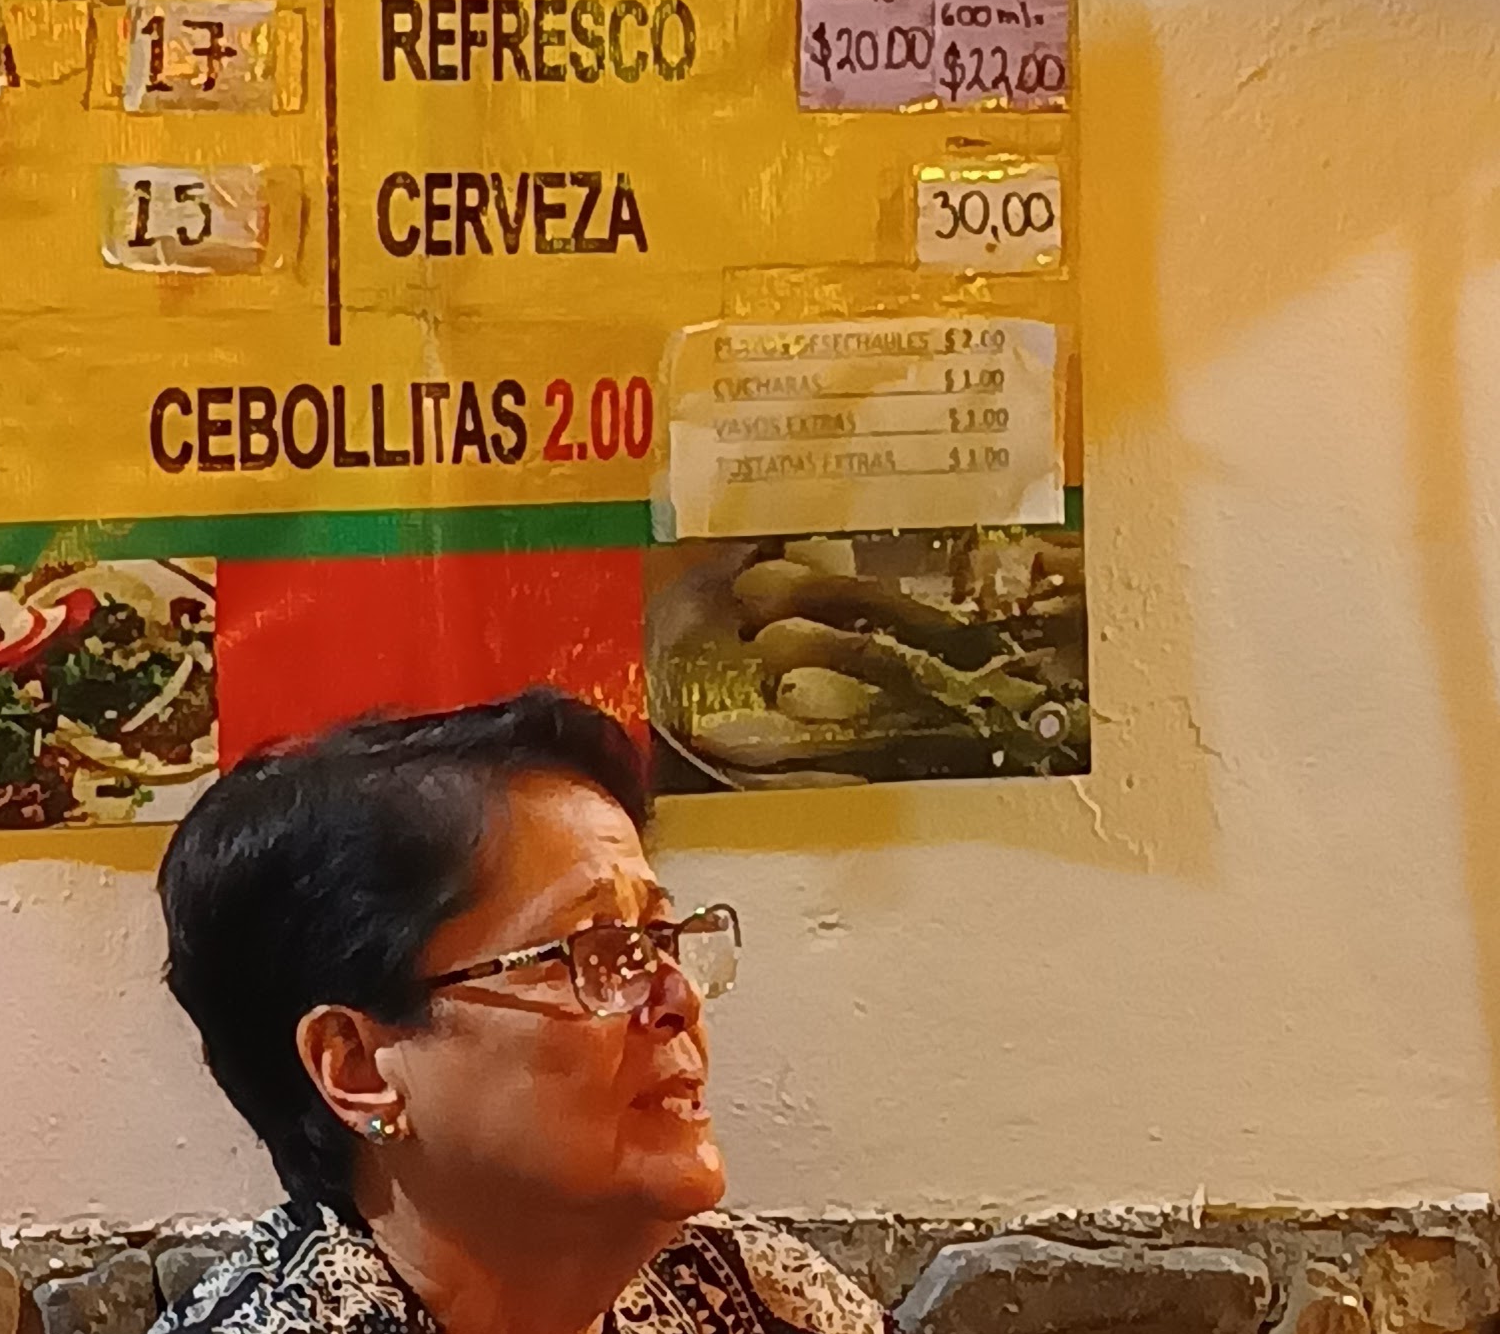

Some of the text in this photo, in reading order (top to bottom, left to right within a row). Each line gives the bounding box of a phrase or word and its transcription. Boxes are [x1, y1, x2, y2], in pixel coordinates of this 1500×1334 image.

[141, 15, 238, 92] 17
[941, 2, 992, 28] 600
[127, 179, 213, 248] 15
[376, 171, 649, 257] CERVEZA
[149, 375, 654, 474] CEBOLLITAS 2.00
